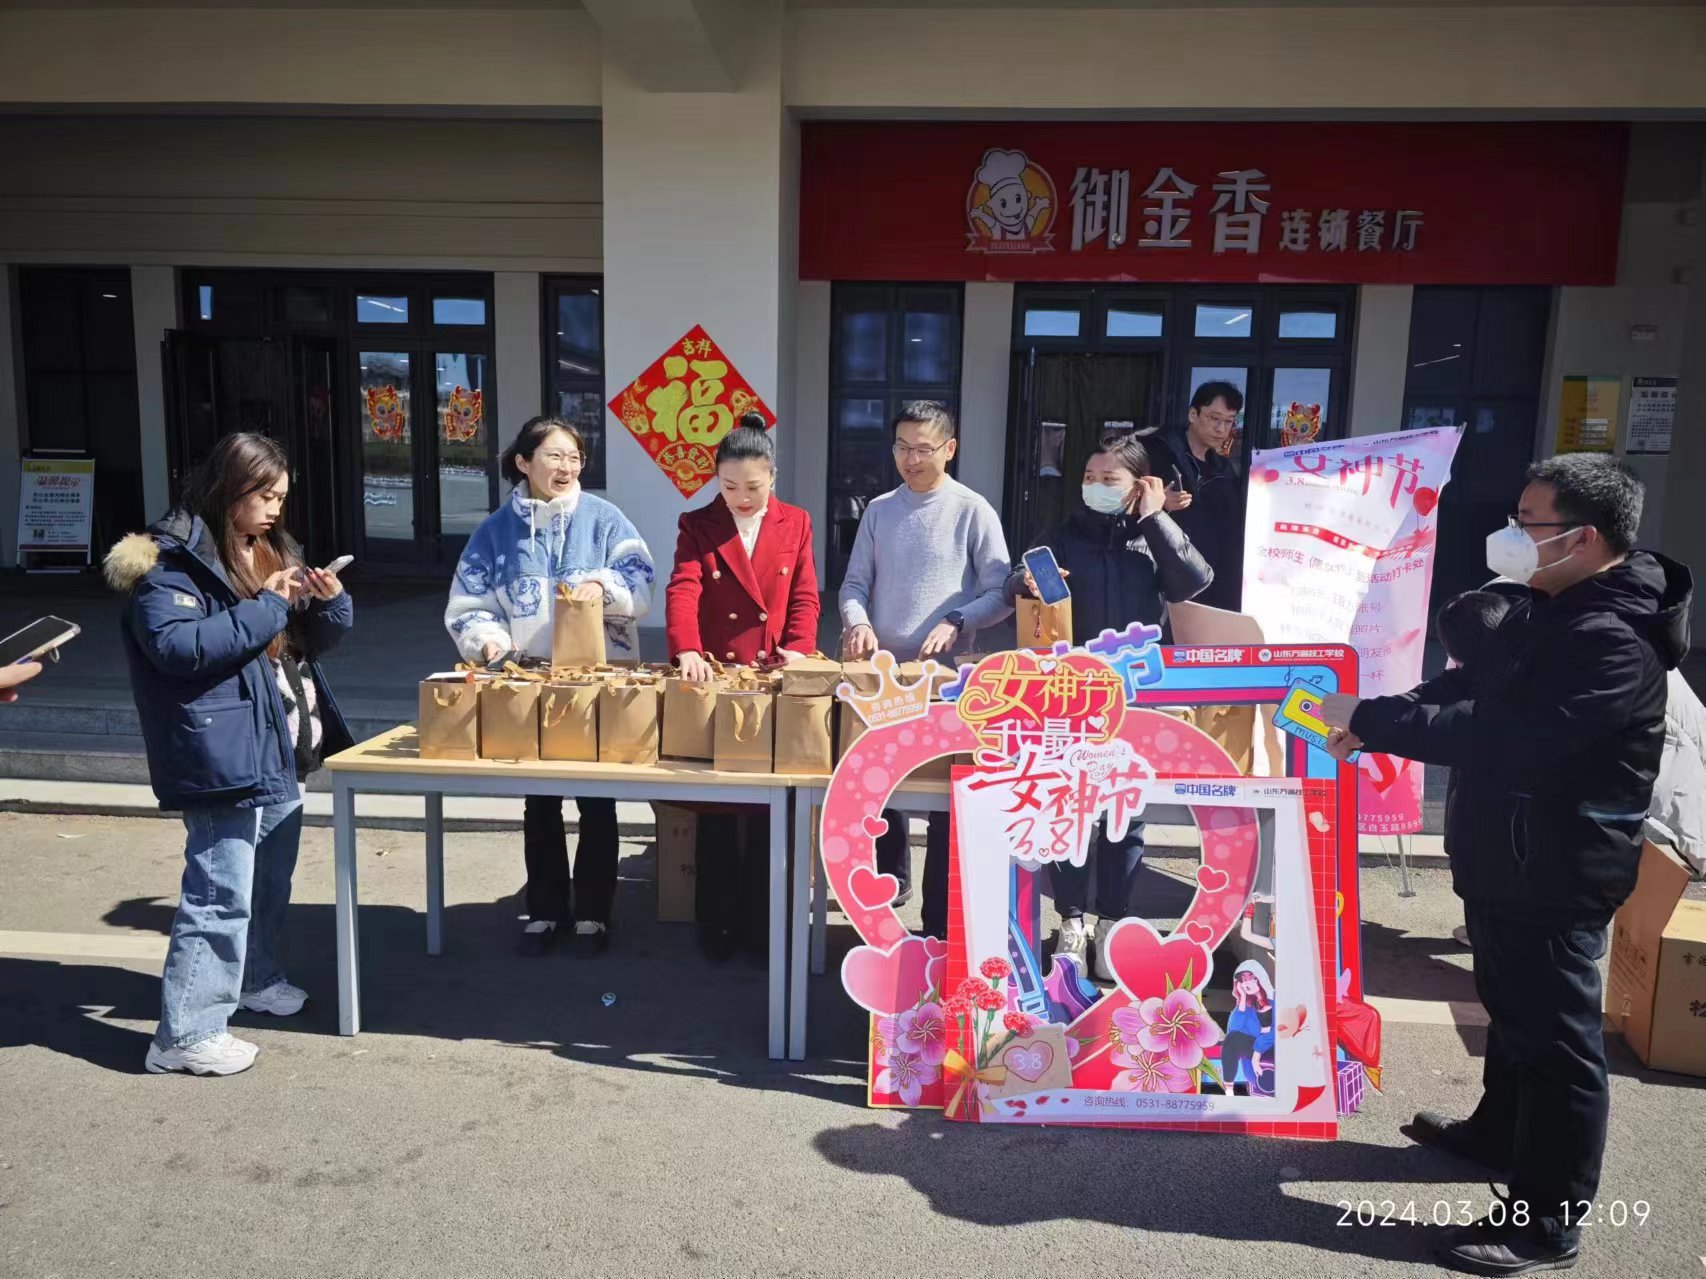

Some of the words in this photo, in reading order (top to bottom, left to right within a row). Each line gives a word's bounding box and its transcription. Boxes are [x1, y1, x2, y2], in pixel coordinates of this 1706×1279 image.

[1068, 166, 1272, 256] 御金香
[1277, 208, 1425, 254] 连锁餐厅
[681, 338, 713, 359] 吉祥
[645, 355, 735, 447] 福
[1288, 453, 1425, 510] 女神节
[1185, 649, 1245, 663] 中国名牌
[959, 654, 1123, 728] 女神节
[1070, 744, 1126, 764] Women's
[1086, 760, 1114, 783] Day
[1186, 784, 1238, 797] 中国名牌
[967, 751, 1151, 859] 女神节
[1136, 1098, 1215, 1111] 0531-88775959
